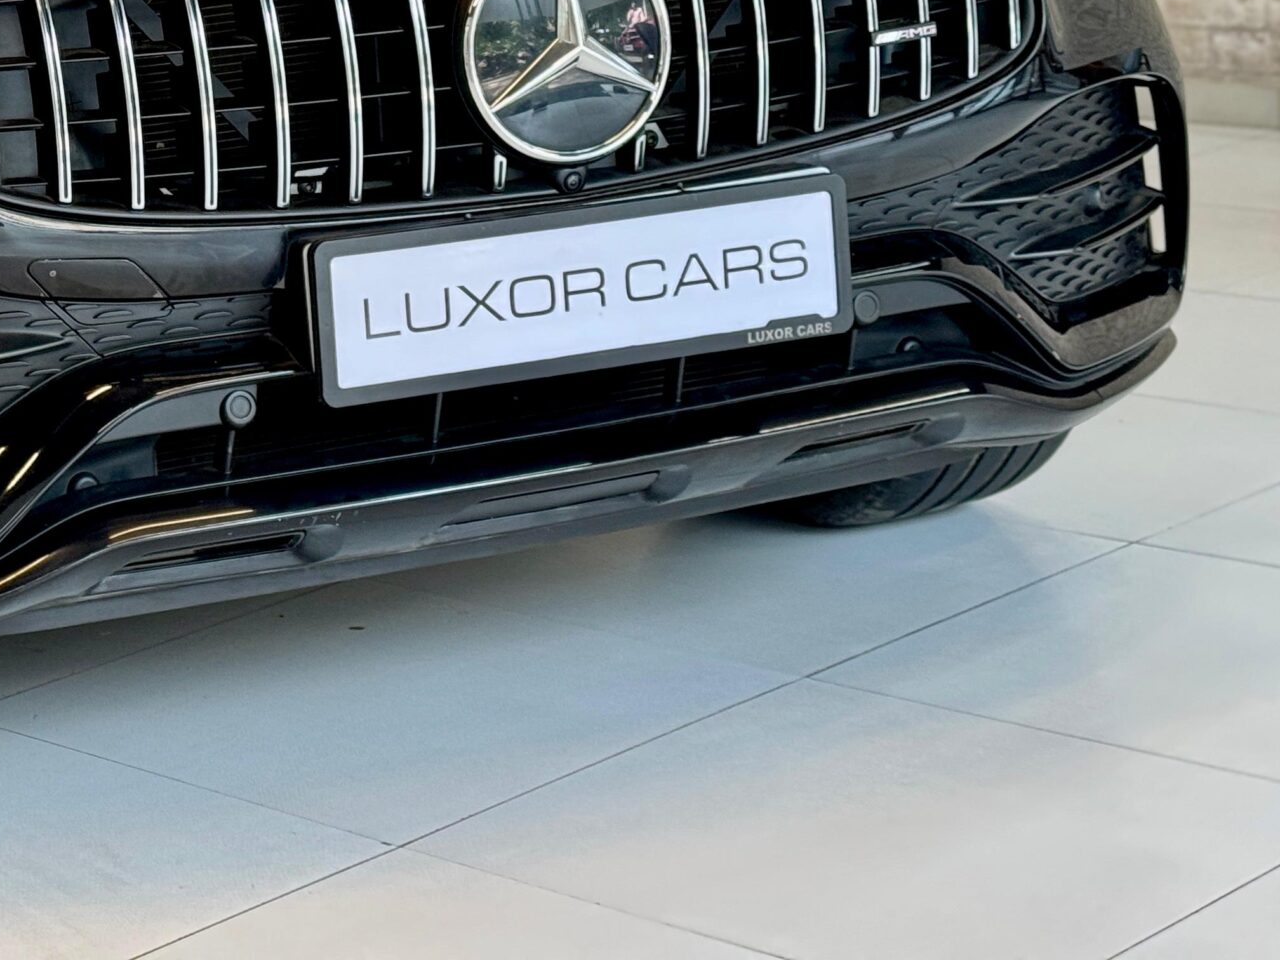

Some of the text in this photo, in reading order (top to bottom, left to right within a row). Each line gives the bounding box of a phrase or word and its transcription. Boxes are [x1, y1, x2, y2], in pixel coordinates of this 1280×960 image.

[364, 239, 809, 340] LUXOR CARS
[747, 321, 833, 344] LUXOR CARS
